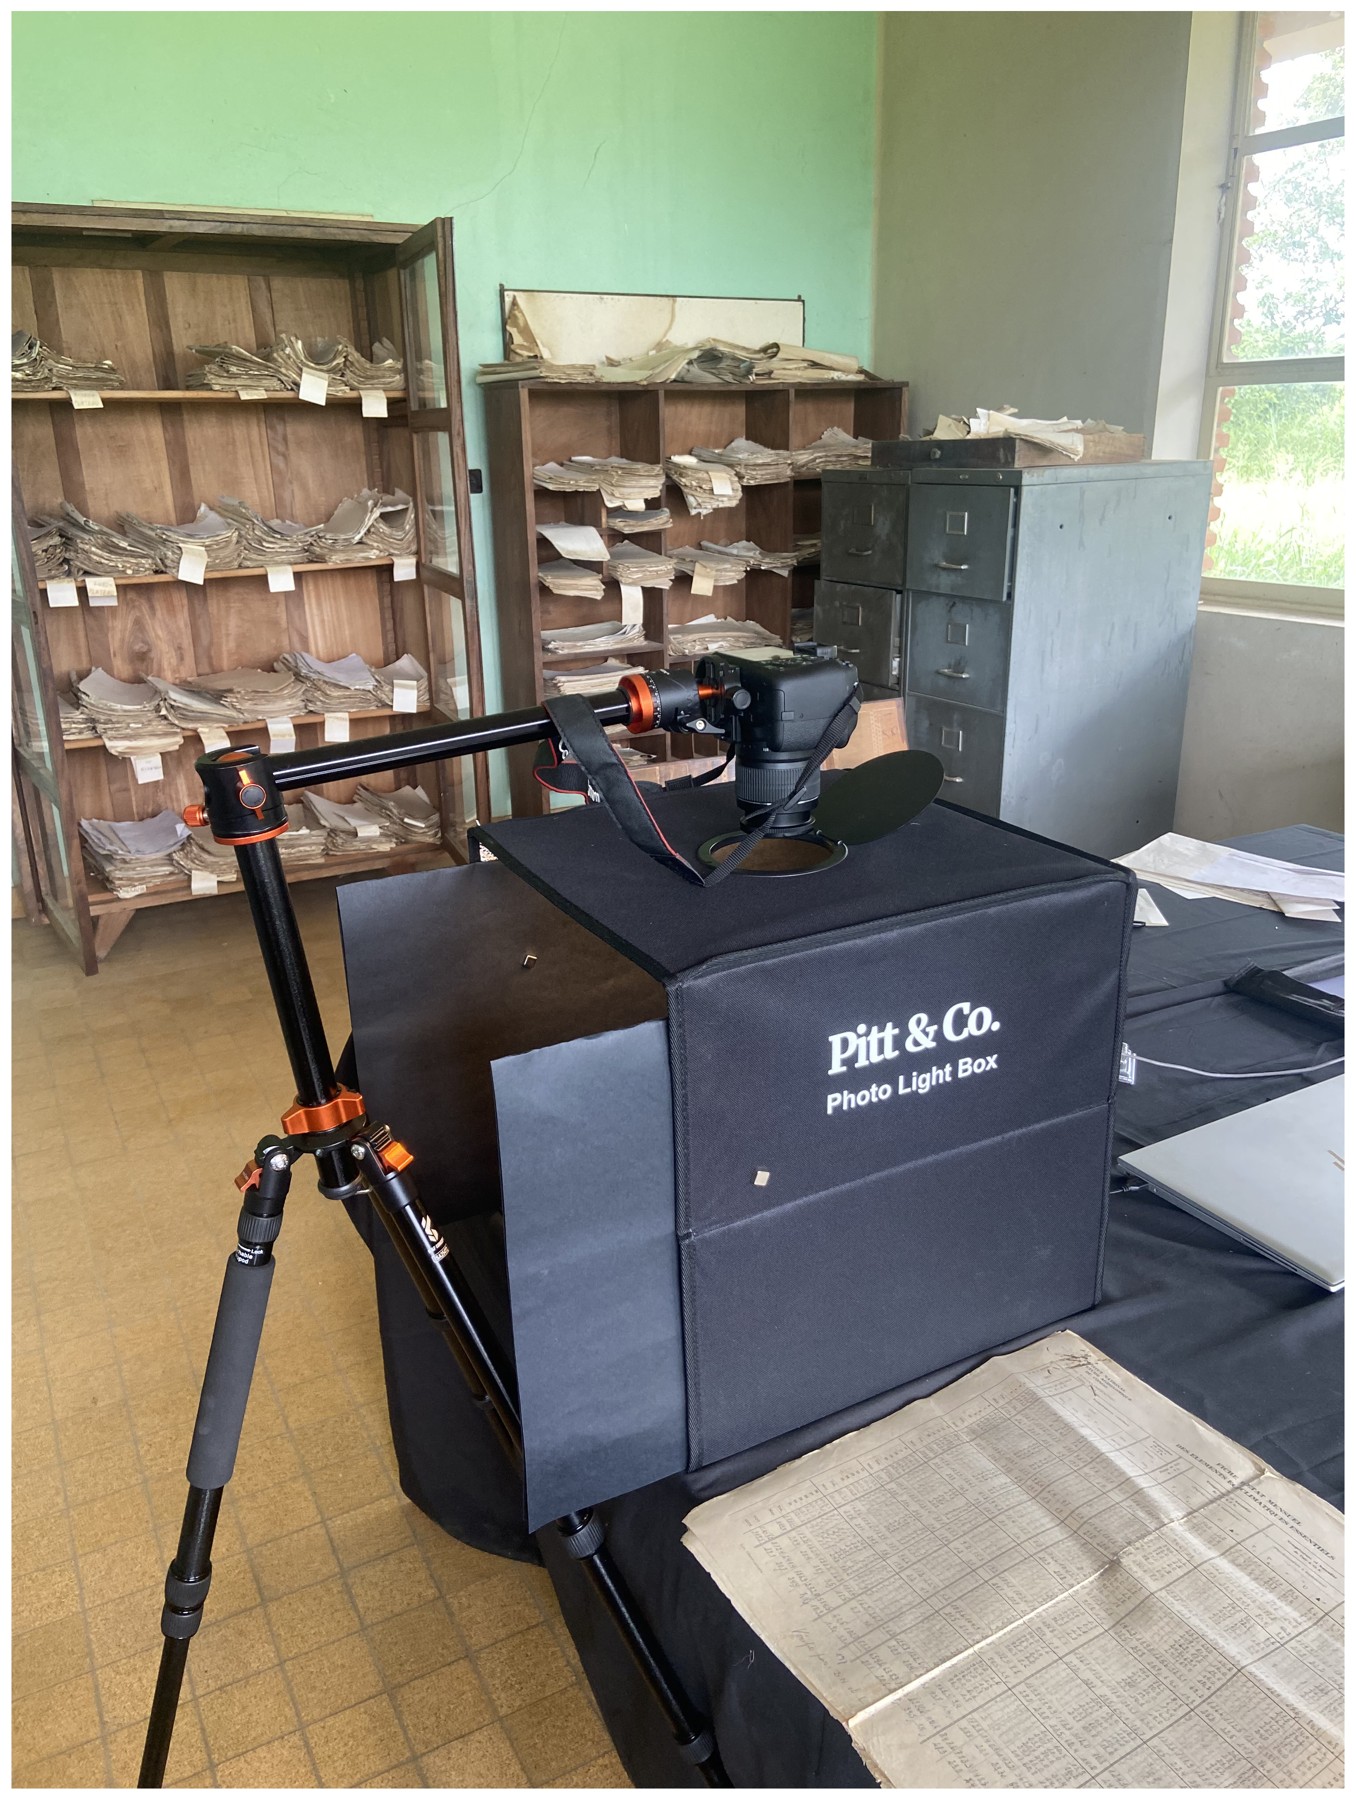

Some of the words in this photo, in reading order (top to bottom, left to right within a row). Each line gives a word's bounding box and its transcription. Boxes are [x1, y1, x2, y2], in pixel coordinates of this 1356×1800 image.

[828, 1021, 899, 1076] Pitt
[905, 1012, 938, 1053] &
[942, 1002, 1001, 1042] Co.
[826, 1083, 892, 1115] Photo
[898, 1063, 952, 1094] Light
[957, 1054, 998, 1079] Box
[1175, 1443, 1190, 1453] DES
[1189, 1453, 1227, 1479] ELEMENTS
[1289, 1525, 1335, 1560] ESSENTIELS
[1216, 1462, 1239, 1479] FICHE
[1267, 1499, 1303, 1526] MENSUEL
